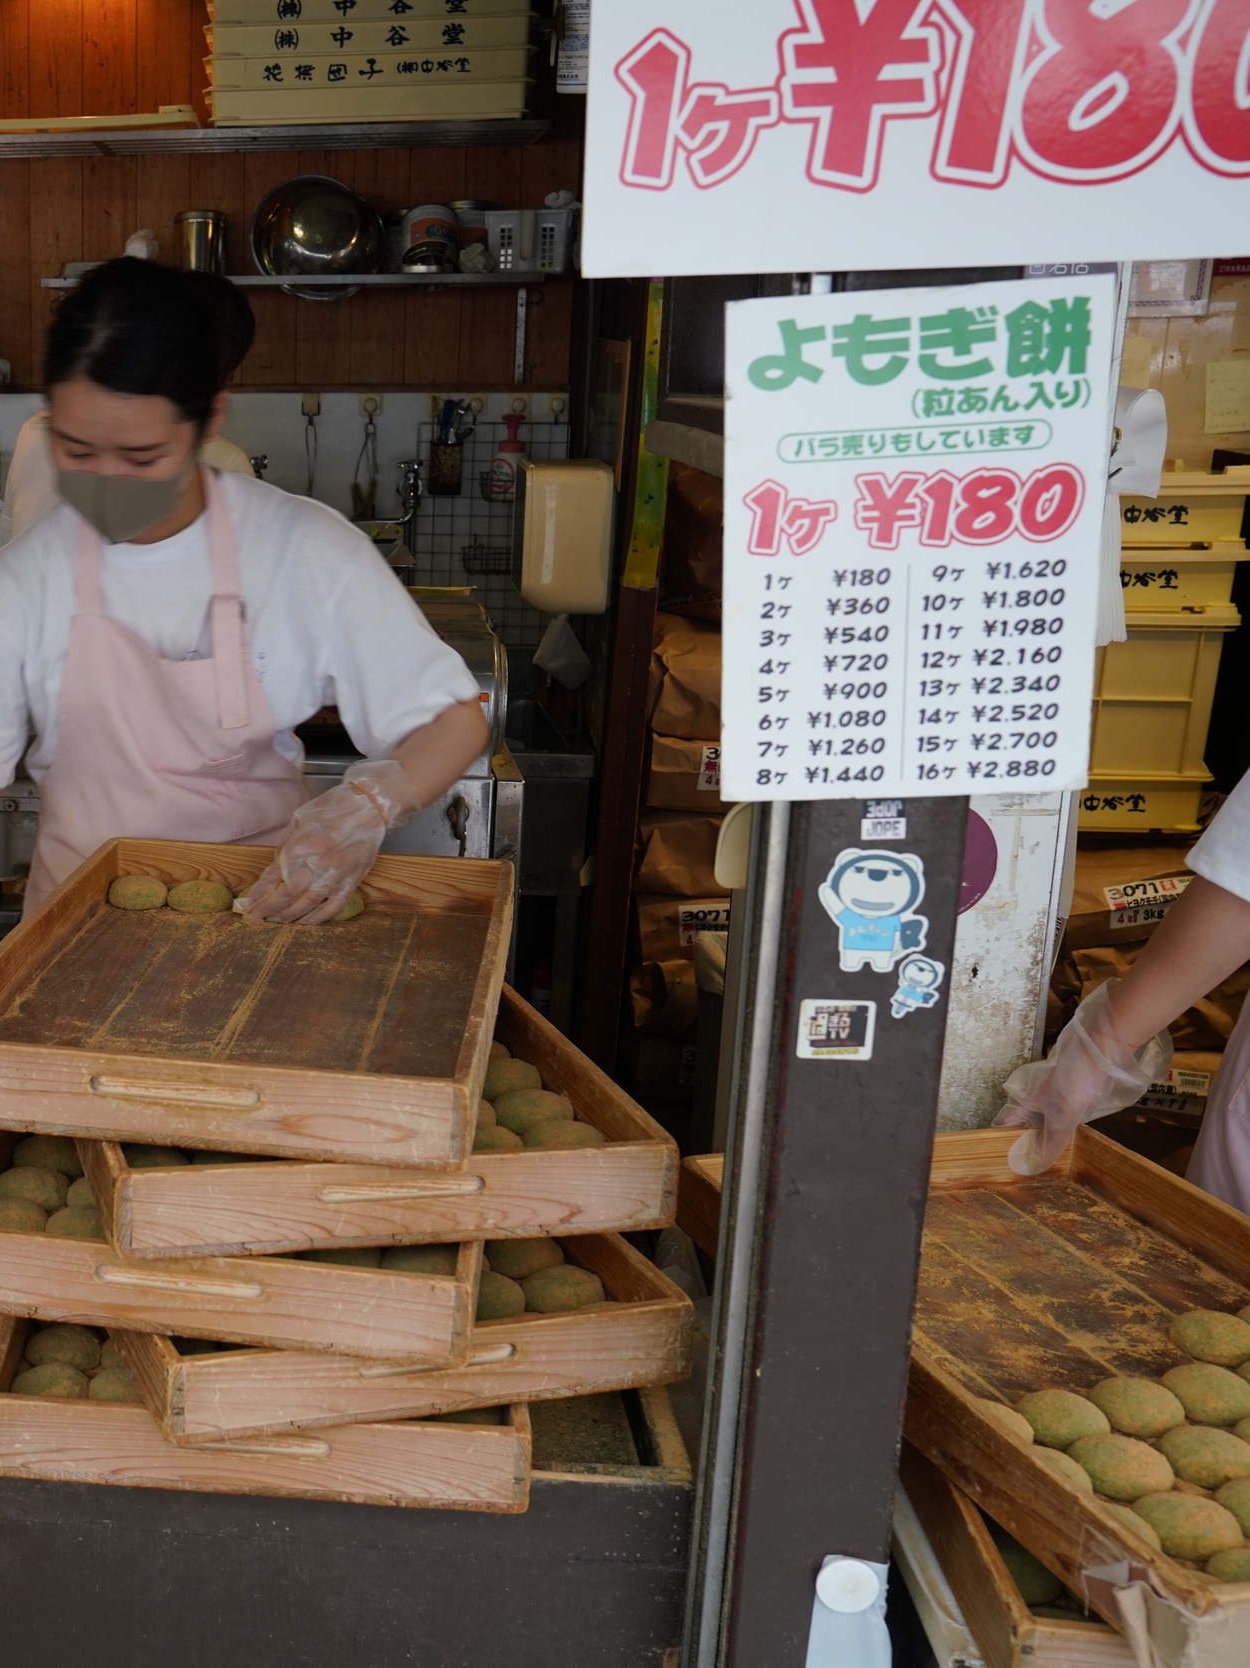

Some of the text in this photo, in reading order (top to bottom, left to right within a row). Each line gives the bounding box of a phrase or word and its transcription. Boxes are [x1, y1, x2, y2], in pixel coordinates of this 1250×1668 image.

[747, 296, 1091, 392] よもぎ餅
[912, 378, 1091, 419] (粒あん入り)
[795, 425, 1036, 458] バラ売りもしています
[854, 462, 1086, 551] ¥180
[1120, 505, 1188, 525] 中谷堂
[833, 568, 891, 587] ¥180
[827, 597, 890, 616] ¥360
[824, 626, 889, 644] ¥540
[823, 654, 888, 673] ¥720
[823, 682, 888, 700] ¥900
[1078, 793, 1146, 813] 中谷堂
[866, 820, 902, 837] JOPE
[1108, 882, 1160, 900] 3071
[1143, 908, 1165, 921] 3kg
